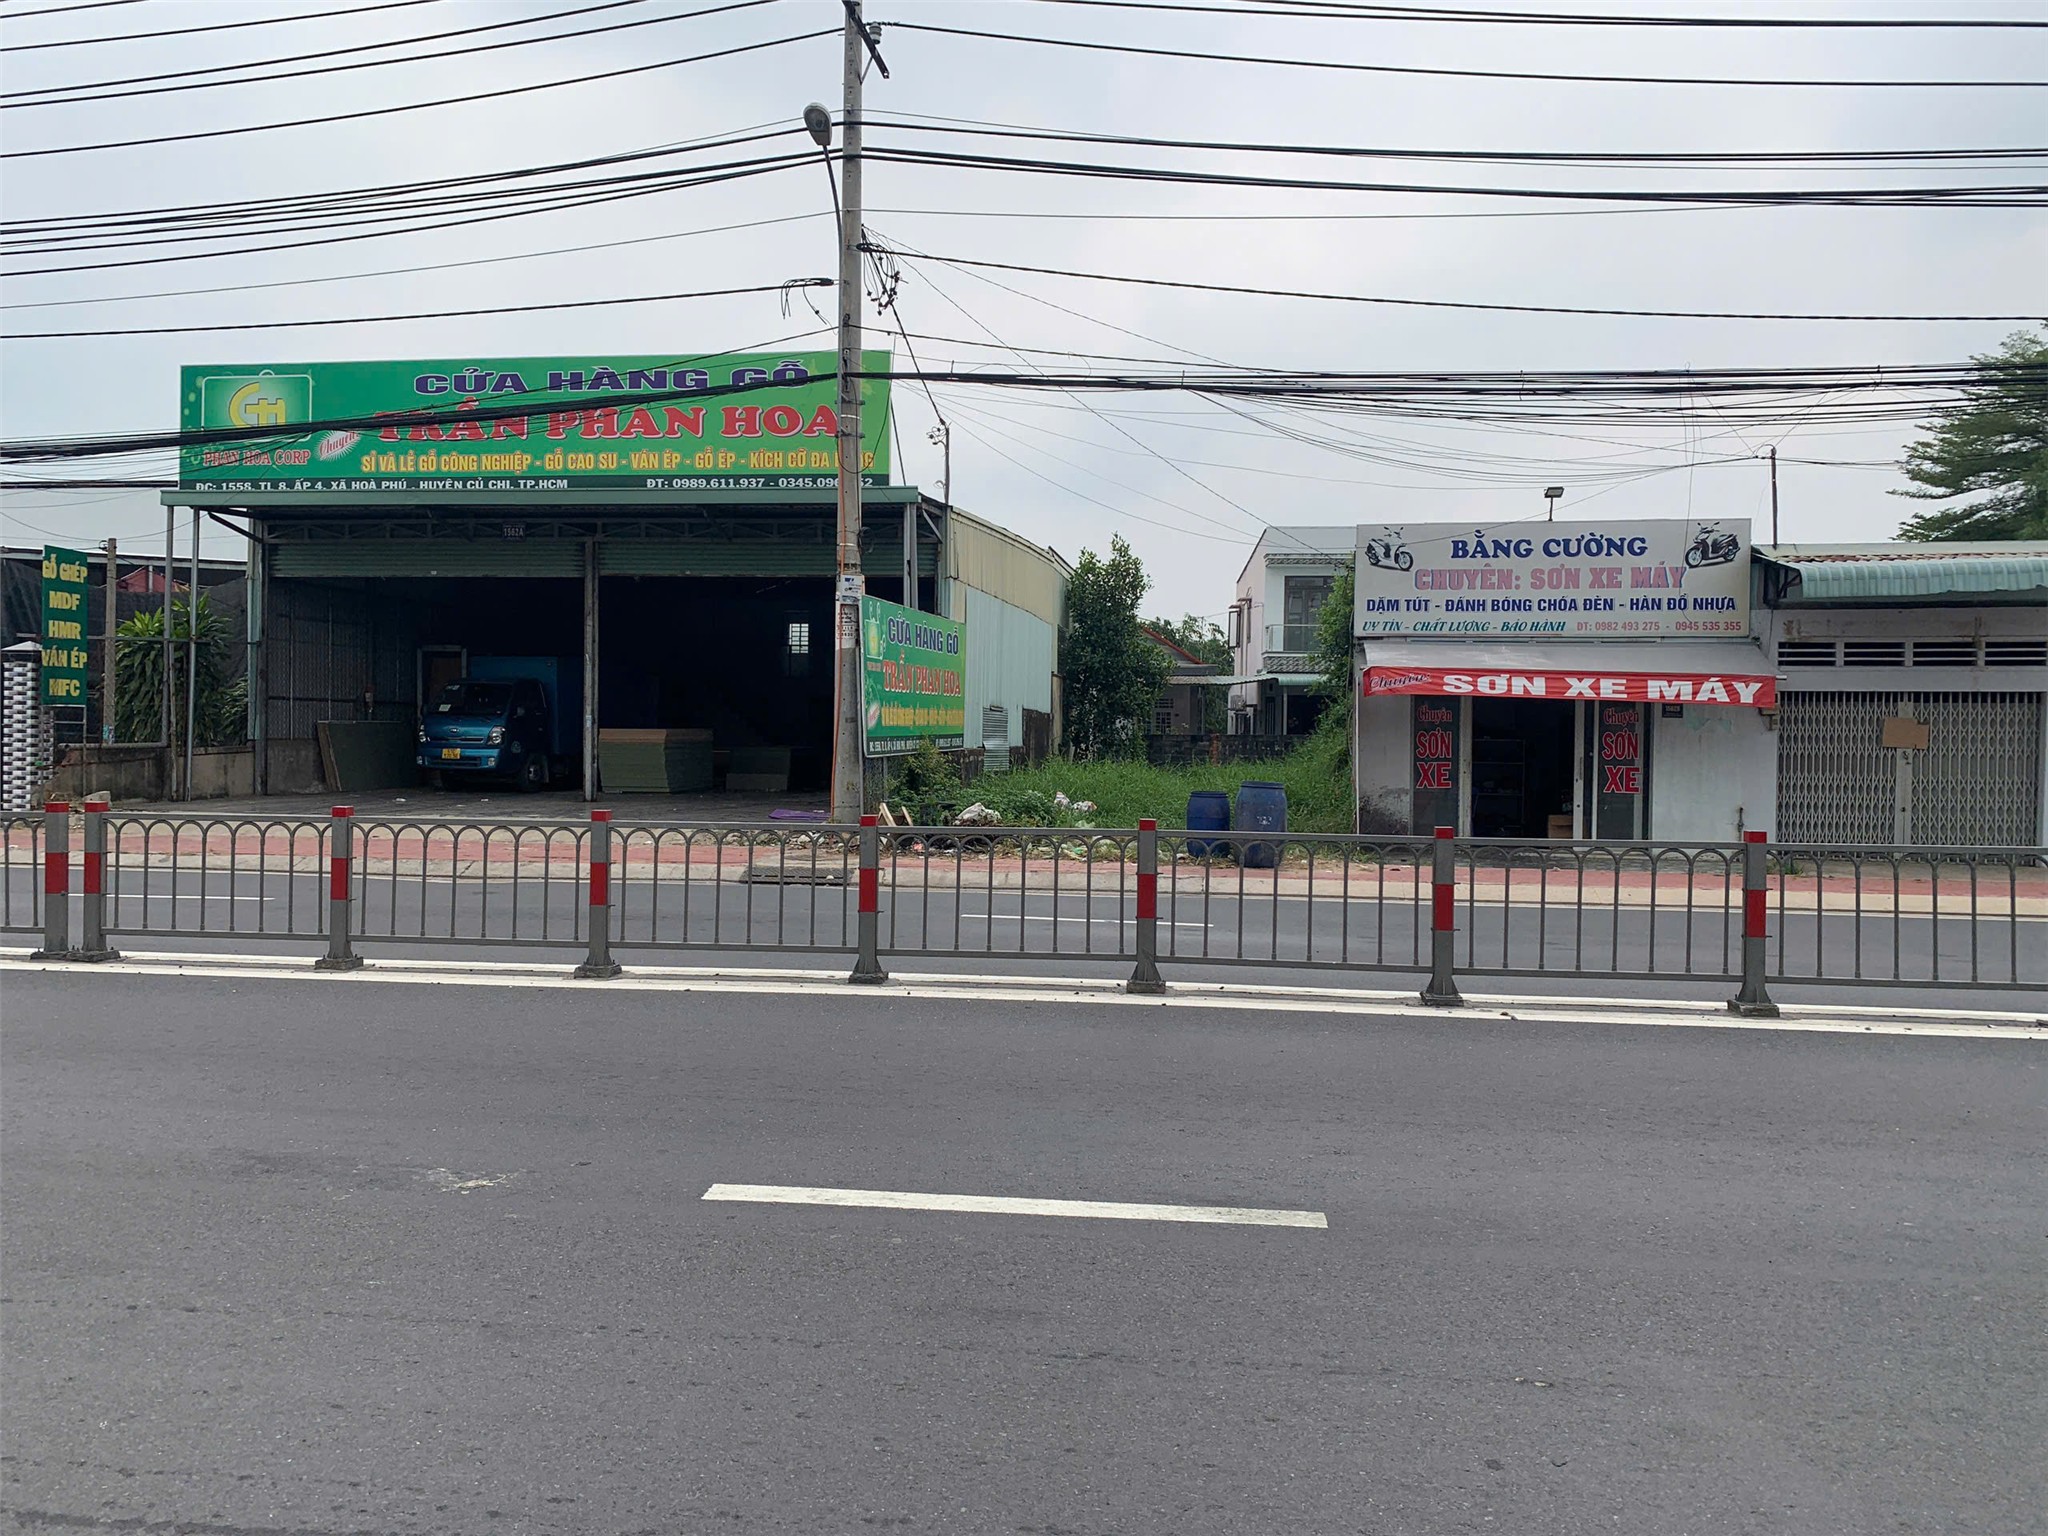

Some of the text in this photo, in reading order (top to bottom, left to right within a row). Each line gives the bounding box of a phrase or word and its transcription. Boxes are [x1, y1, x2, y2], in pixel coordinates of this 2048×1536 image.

[414, 367, 529, 395] CỬA
[547, 365, 709, 392] HÀNG
[545, 404, 708, 440] PHAN
[720, 404, 838, 439] HOA
[203, 449, 311, 466] PHAN HOA CORP
[440, 451, 478, 472] CÔNG
[481, 451, 532, 475] NGHIỆP
[567, 453, 595, 471] CAO
[599, 452, 618, 470] SU
[663, 448, 681, 470] ÉP
[718, 448, 736, 469] ÉP
[749, 448, 783, 469] KÍCH
[810, 450, 831, 468] ĐA
[331, 479, 346, 490] XÃ
[352, 479, 377, 490] HOÀ
[382, 479, 407, 490] PHÚ
[466, 477, 484, 490] CỦ
[518, 479, 568, 490] TP.HCM
[646, 478, 669, 488] ĐT:
[672, 477, 765, 489] 0989.611.937
[1451, 529, 1648, 559] BẰNG CƯỜNG
[1415, 561, 1687, 591] CHUYÊN: SƠN XE MÁY
[49, 591, 80, 610] MDF
[1405, 595, 1431, 612] TÚT
[1445, 595, 1486, 612] ĐÁNH
[1491, 595, 1532, 612] BÓNG
[1537, 595, 1578, 612] CHÓA
[1583, 594, 1614, 611] ĐÈN
[1630, 594, 1662, 611] HÀN
[1693, 596, 1736, 614] NHỰA
[48, 620, 81, 640] HMR
[887, 611, 912, 648] CỬA
[915, 620, 943, 653] HÀNG
[1362, 620, 1378, 632] UY
[1381, 618, 1403, 631] TÍN
[1412, 617, 1447, 632] CHẤT
[1449, 619, 1491, 634] LƯỢNG
[1595, 621, 1618, 631] 0982
[1621, 621, 1639, 631] 493
[1642, 621, 1660, 631] 275
[1675, 621, 1699, 631] 0945
[1702, 621, 1721, 631] 535
[1723, 621, 1741, 631] 355
[41, 645, 87, 669] VÁN ÉP
[49, 679, 80, 697] MFC
[915, 664, 943, 696] PHAN
[943, 669, 962, 698] HOA
[1442, 674, 1546, 696] SƠN
[1563, 677, 1627, 698] XE
[1647, 677, 1763, 704] MÁY
[1416, 727, 1452, 758] SƠN
[1602, 727, 1640, 760] SƠN
[1416, 762, 1452, 789] XE
[1603, 765, 1641, 794] XE
